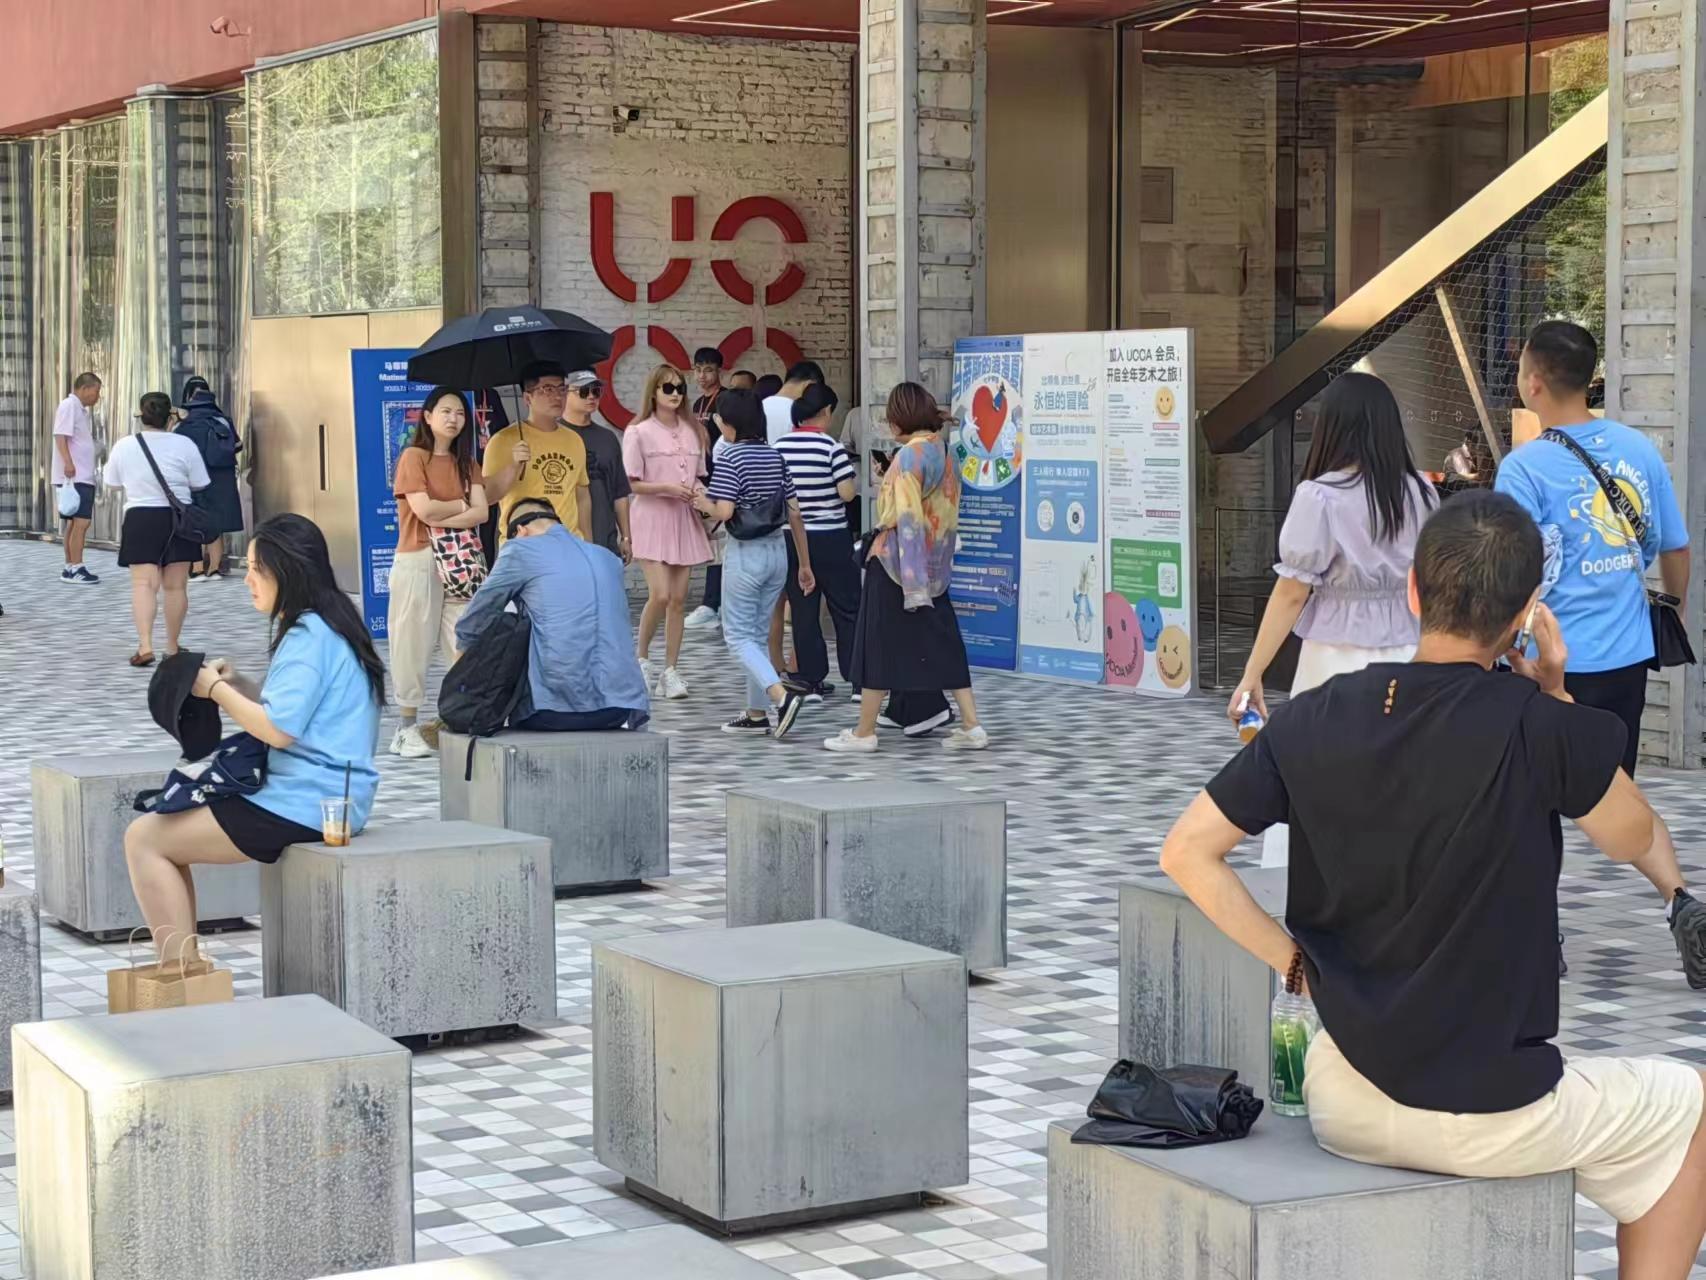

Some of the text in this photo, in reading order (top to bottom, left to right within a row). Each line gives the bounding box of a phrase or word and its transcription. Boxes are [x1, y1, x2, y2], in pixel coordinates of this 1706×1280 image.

[1127, 348, 1152, 361] UCCA
[1033, 391, 1089, 410] 永恒的冒险
[1582, 553, 1634, 575] DODGER
